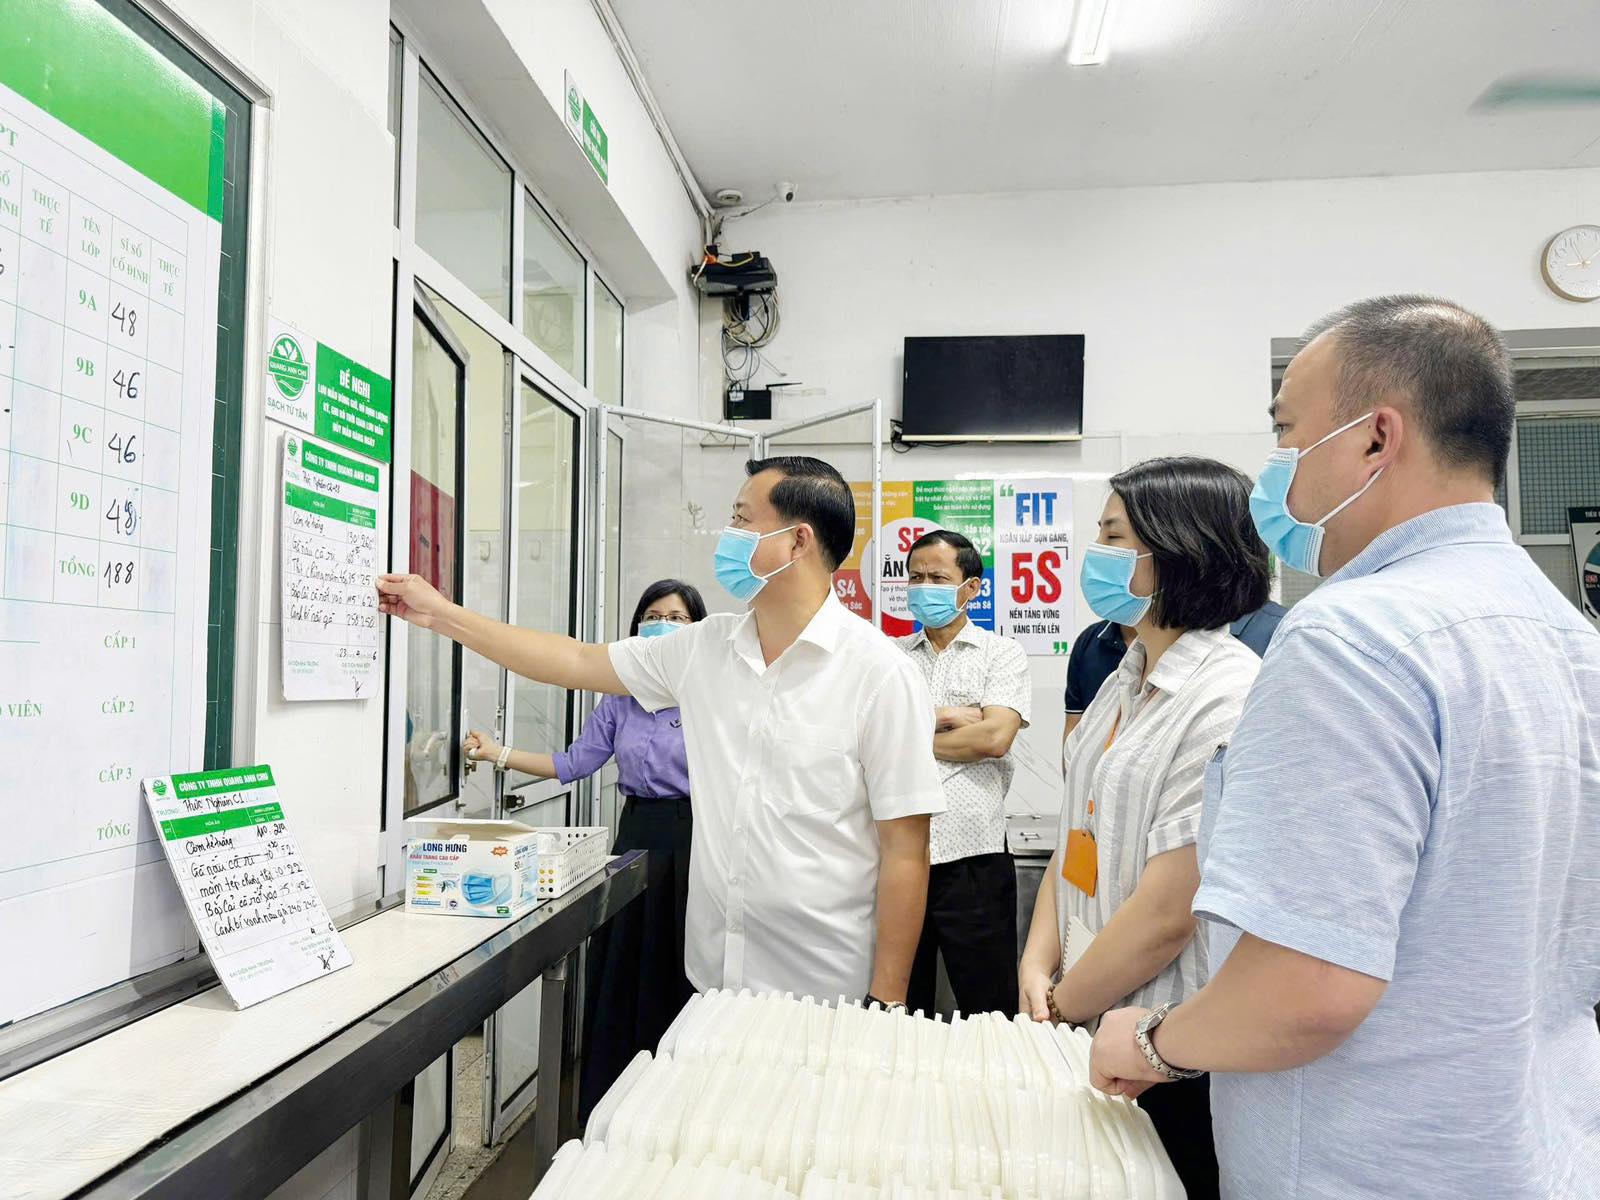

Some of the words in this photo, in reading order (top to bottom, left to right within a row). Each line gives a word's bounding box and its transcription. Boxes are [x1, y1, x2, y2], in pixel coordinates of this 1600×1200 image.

[79, 289, 97, 312] 9A
[111, 302, 137, 337] 48
[76, 357, 95, 377] 9B
[112, 369, 140, 399] 46
[351, 375, 371, 403] NGHỊ
[267, 397, 285, 411] SẠCH
[295, 408, 308, 420] TÂM
[73, 424, 93, 444] 9C
[108, 433, 136, 464] 46
[70, 491, 90, 511] 9D
[1016, 492, 1057, 527] FIT
[1034, 534, 1047, 545] GỌN
[59, 556, 96, 578] TỔNG
[103, 561, 134, 588] 188
[883, 555, 904, 578] ĂN
[1011, 551, 1062, 604] 5S
[837, 579, 856, 597] S4
[1013, 624, 1030, 634] VÀNG
[1048, 623, 1060, 634] LÊN
[104, 631, 128, 649] CẤP
[132, 637, 136, 649] 1
[7, 699, 43, 718] VIÊN
[101, 696, 126, 714] CẤP
[128, 701, 135, 714] 2
[99, 763, 124, 783] CẤP
[126, 767, 133, 780] 3
[179, 780, 198, 792] CÔNG
[223, 776, 243, 787] QUANG
[97, 820, 131, 840] TỔNG
[423, 843, 443, 852] LONG
[445, 844, 467, 853] HƯNG
